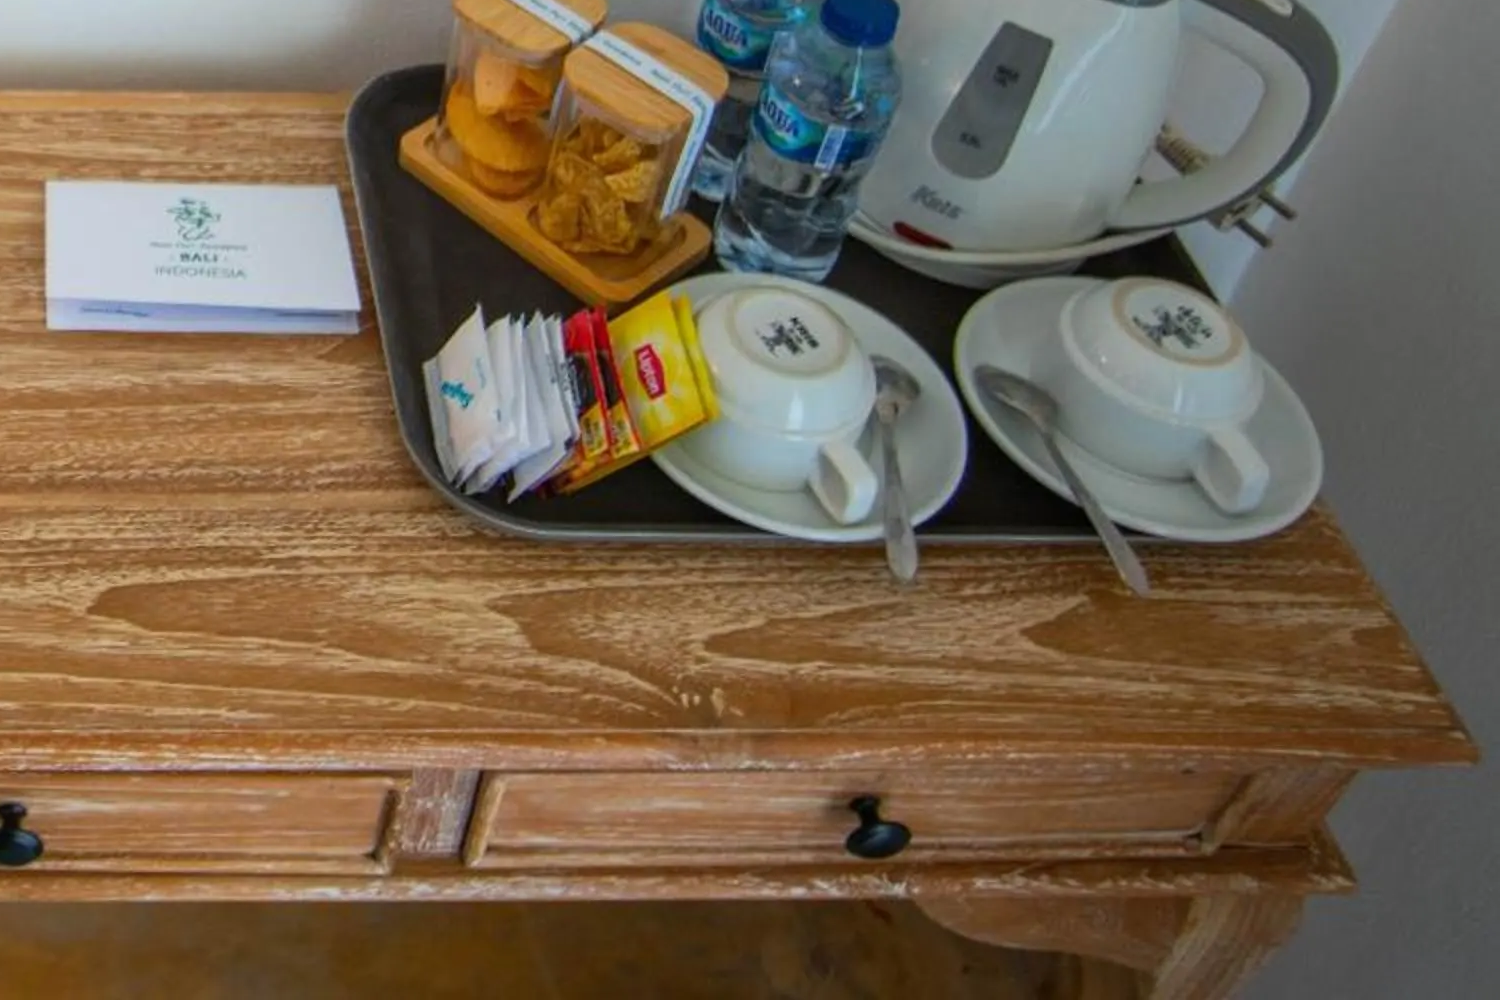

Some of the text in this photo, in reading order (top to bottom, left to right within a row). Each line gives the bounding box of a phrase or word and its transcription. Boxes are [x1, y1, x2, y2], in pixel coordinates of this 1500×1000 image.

[703, 8, 748, 47] AQUA
[180, 252, 219, 263] BALI
[154, 265, 248, 280] INDONESIA
